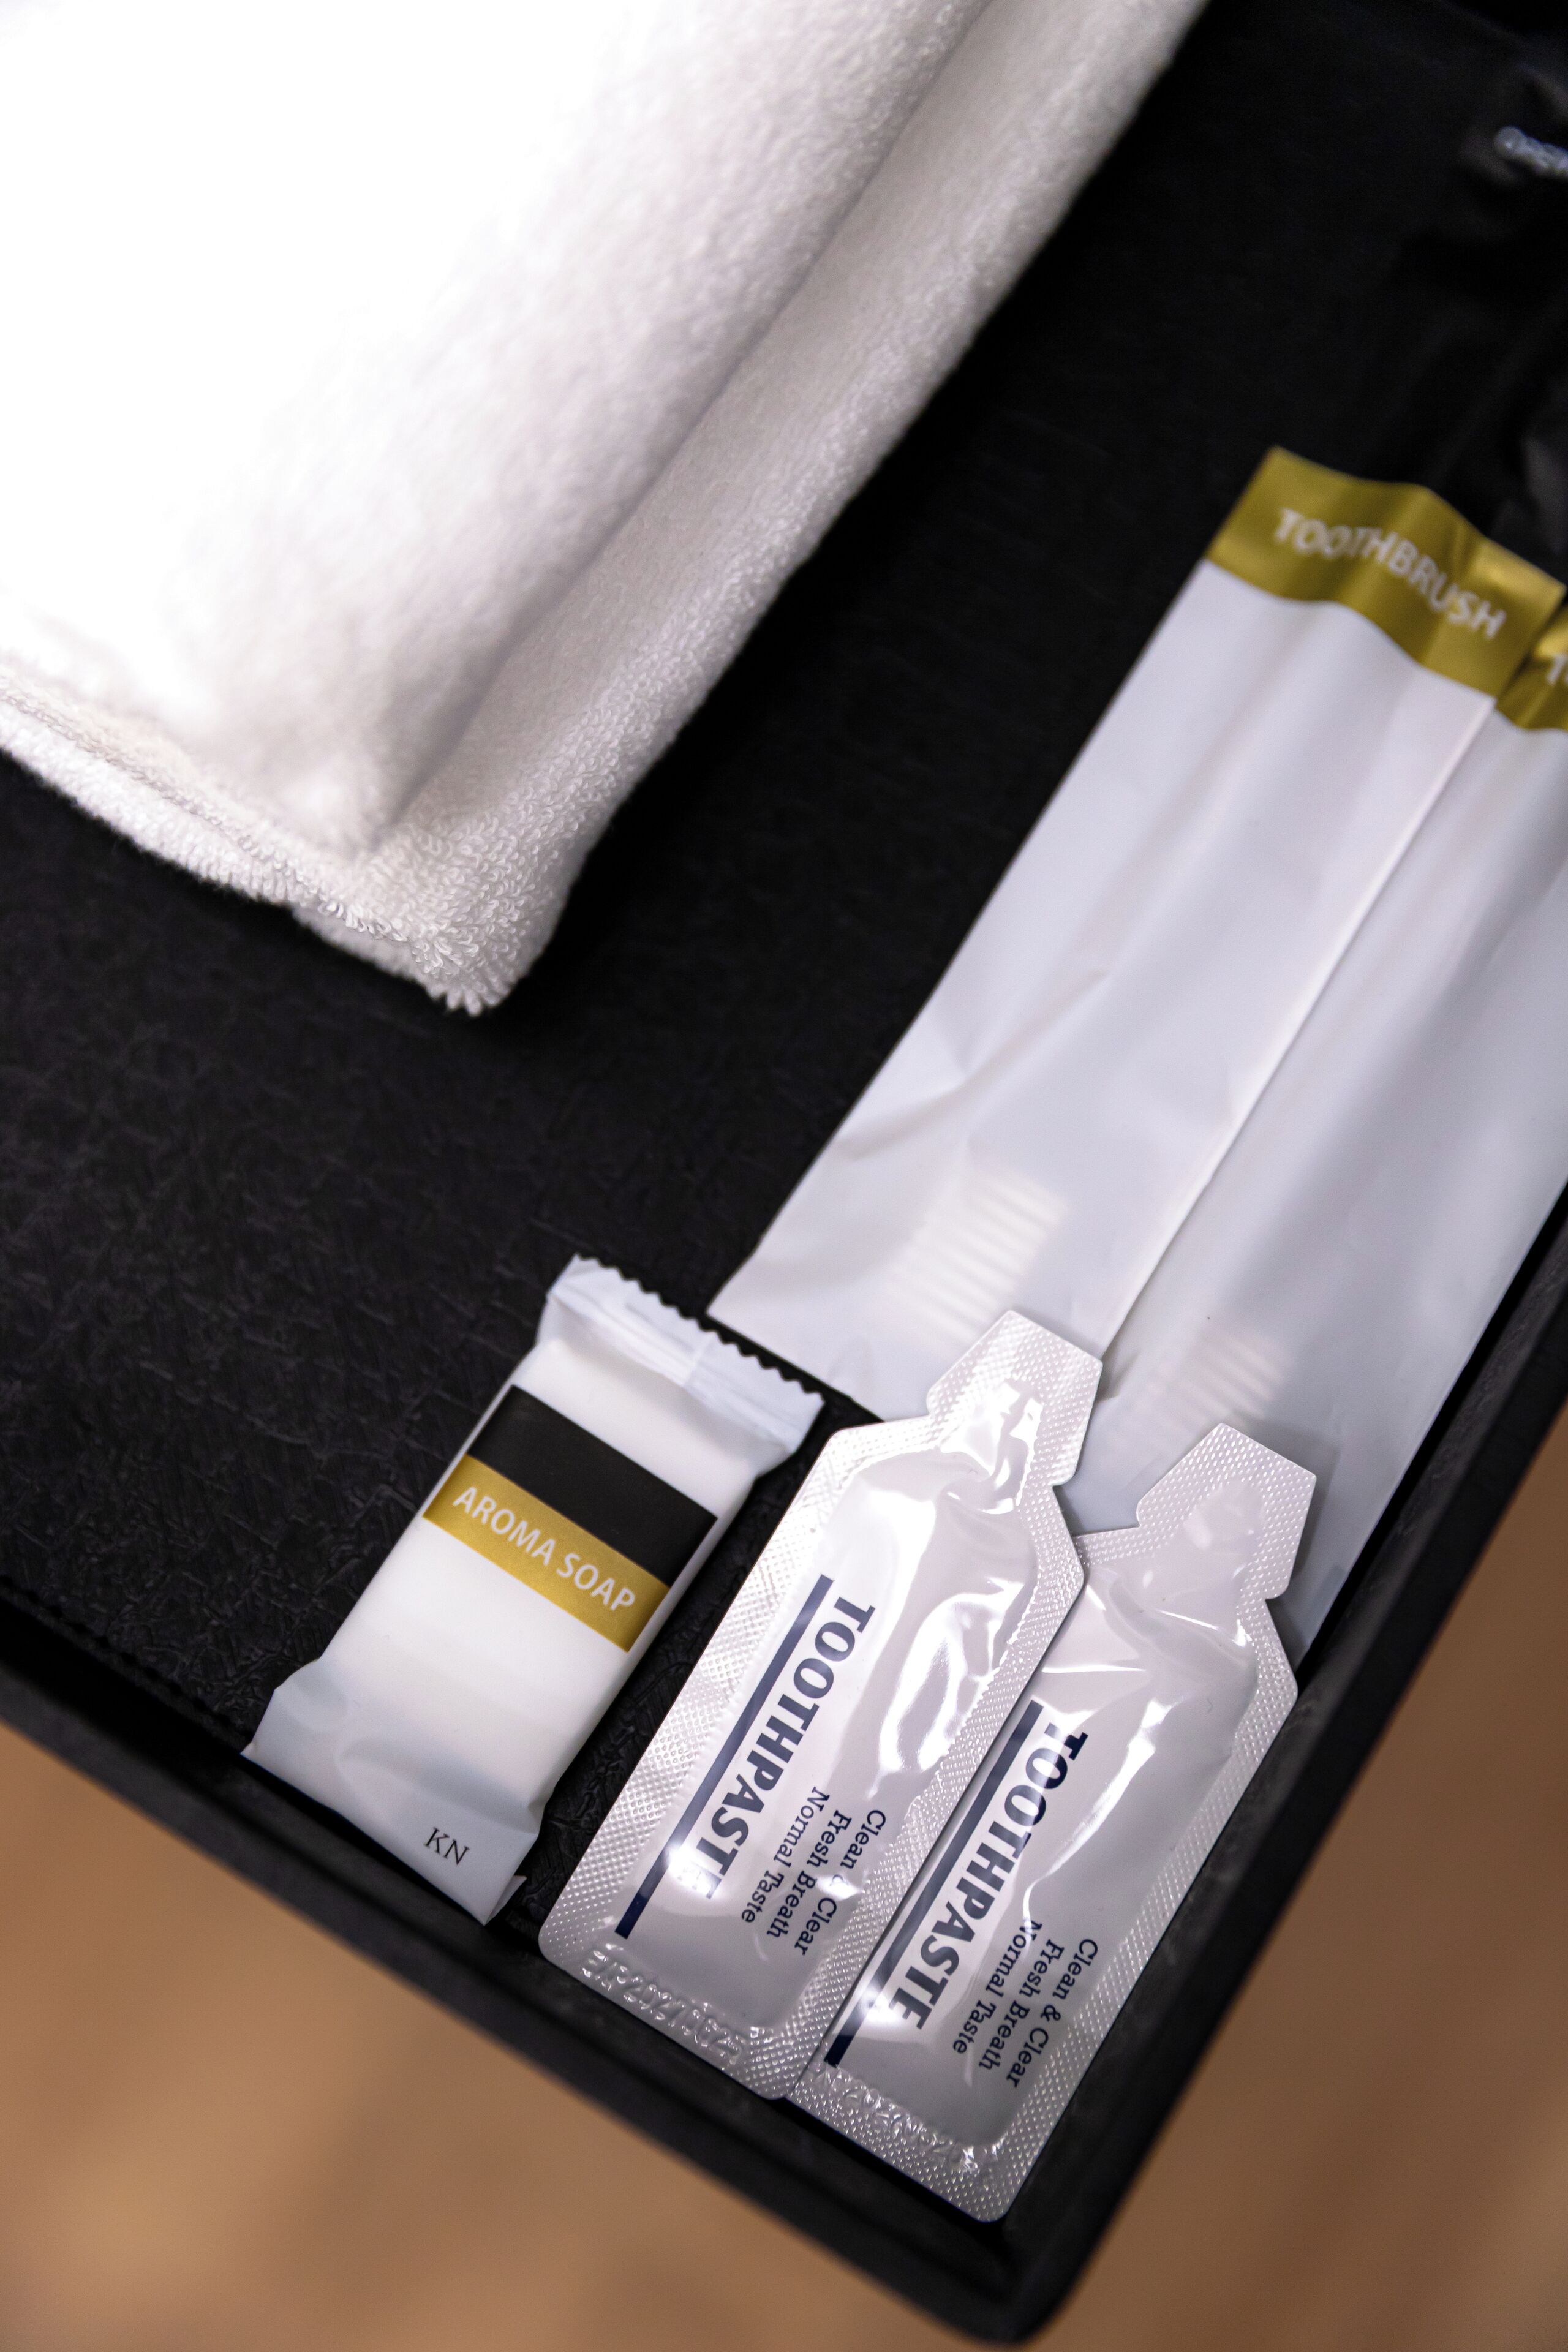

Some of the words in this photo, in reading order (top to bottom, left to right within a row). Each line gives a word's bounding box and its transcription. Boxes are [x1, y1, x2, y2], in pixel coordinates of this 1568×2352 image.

[1273, 507, 1507, 639] TOOTHBRUSH
[451, 1485, 556, 1567] AROMA
[556, 1553, 636, 1611] SOAP
[681, 1596, 876, 1899] TOOTHPASTE
[423, 1826, 470, 1866] KN
[773, 1786, 831, 1868] Normal
[806, 1809, 853, 1868] Fresh
[840, 1809, 886, 1869] Clean
[741, 1870, 785, 1923] Taste
[766, 1870, 818, 1939] Breath
[888, 1722, 1088, 2029] TOOTHPASTE
[794, 1897, 837, 1955] Clear
[986, 1919, 1042, 1998] Normal
[1019, 1939, 1065, 1998] Fresh
[1052, 1939, 1098, 2000] Clean
[952, 2000, 997, 2054] Taste
[978, 2000, 1030, 2070] Breath
[1040, 2003, 1061, 2022] &
[1006, 2027, 1049, 2088] Clear
